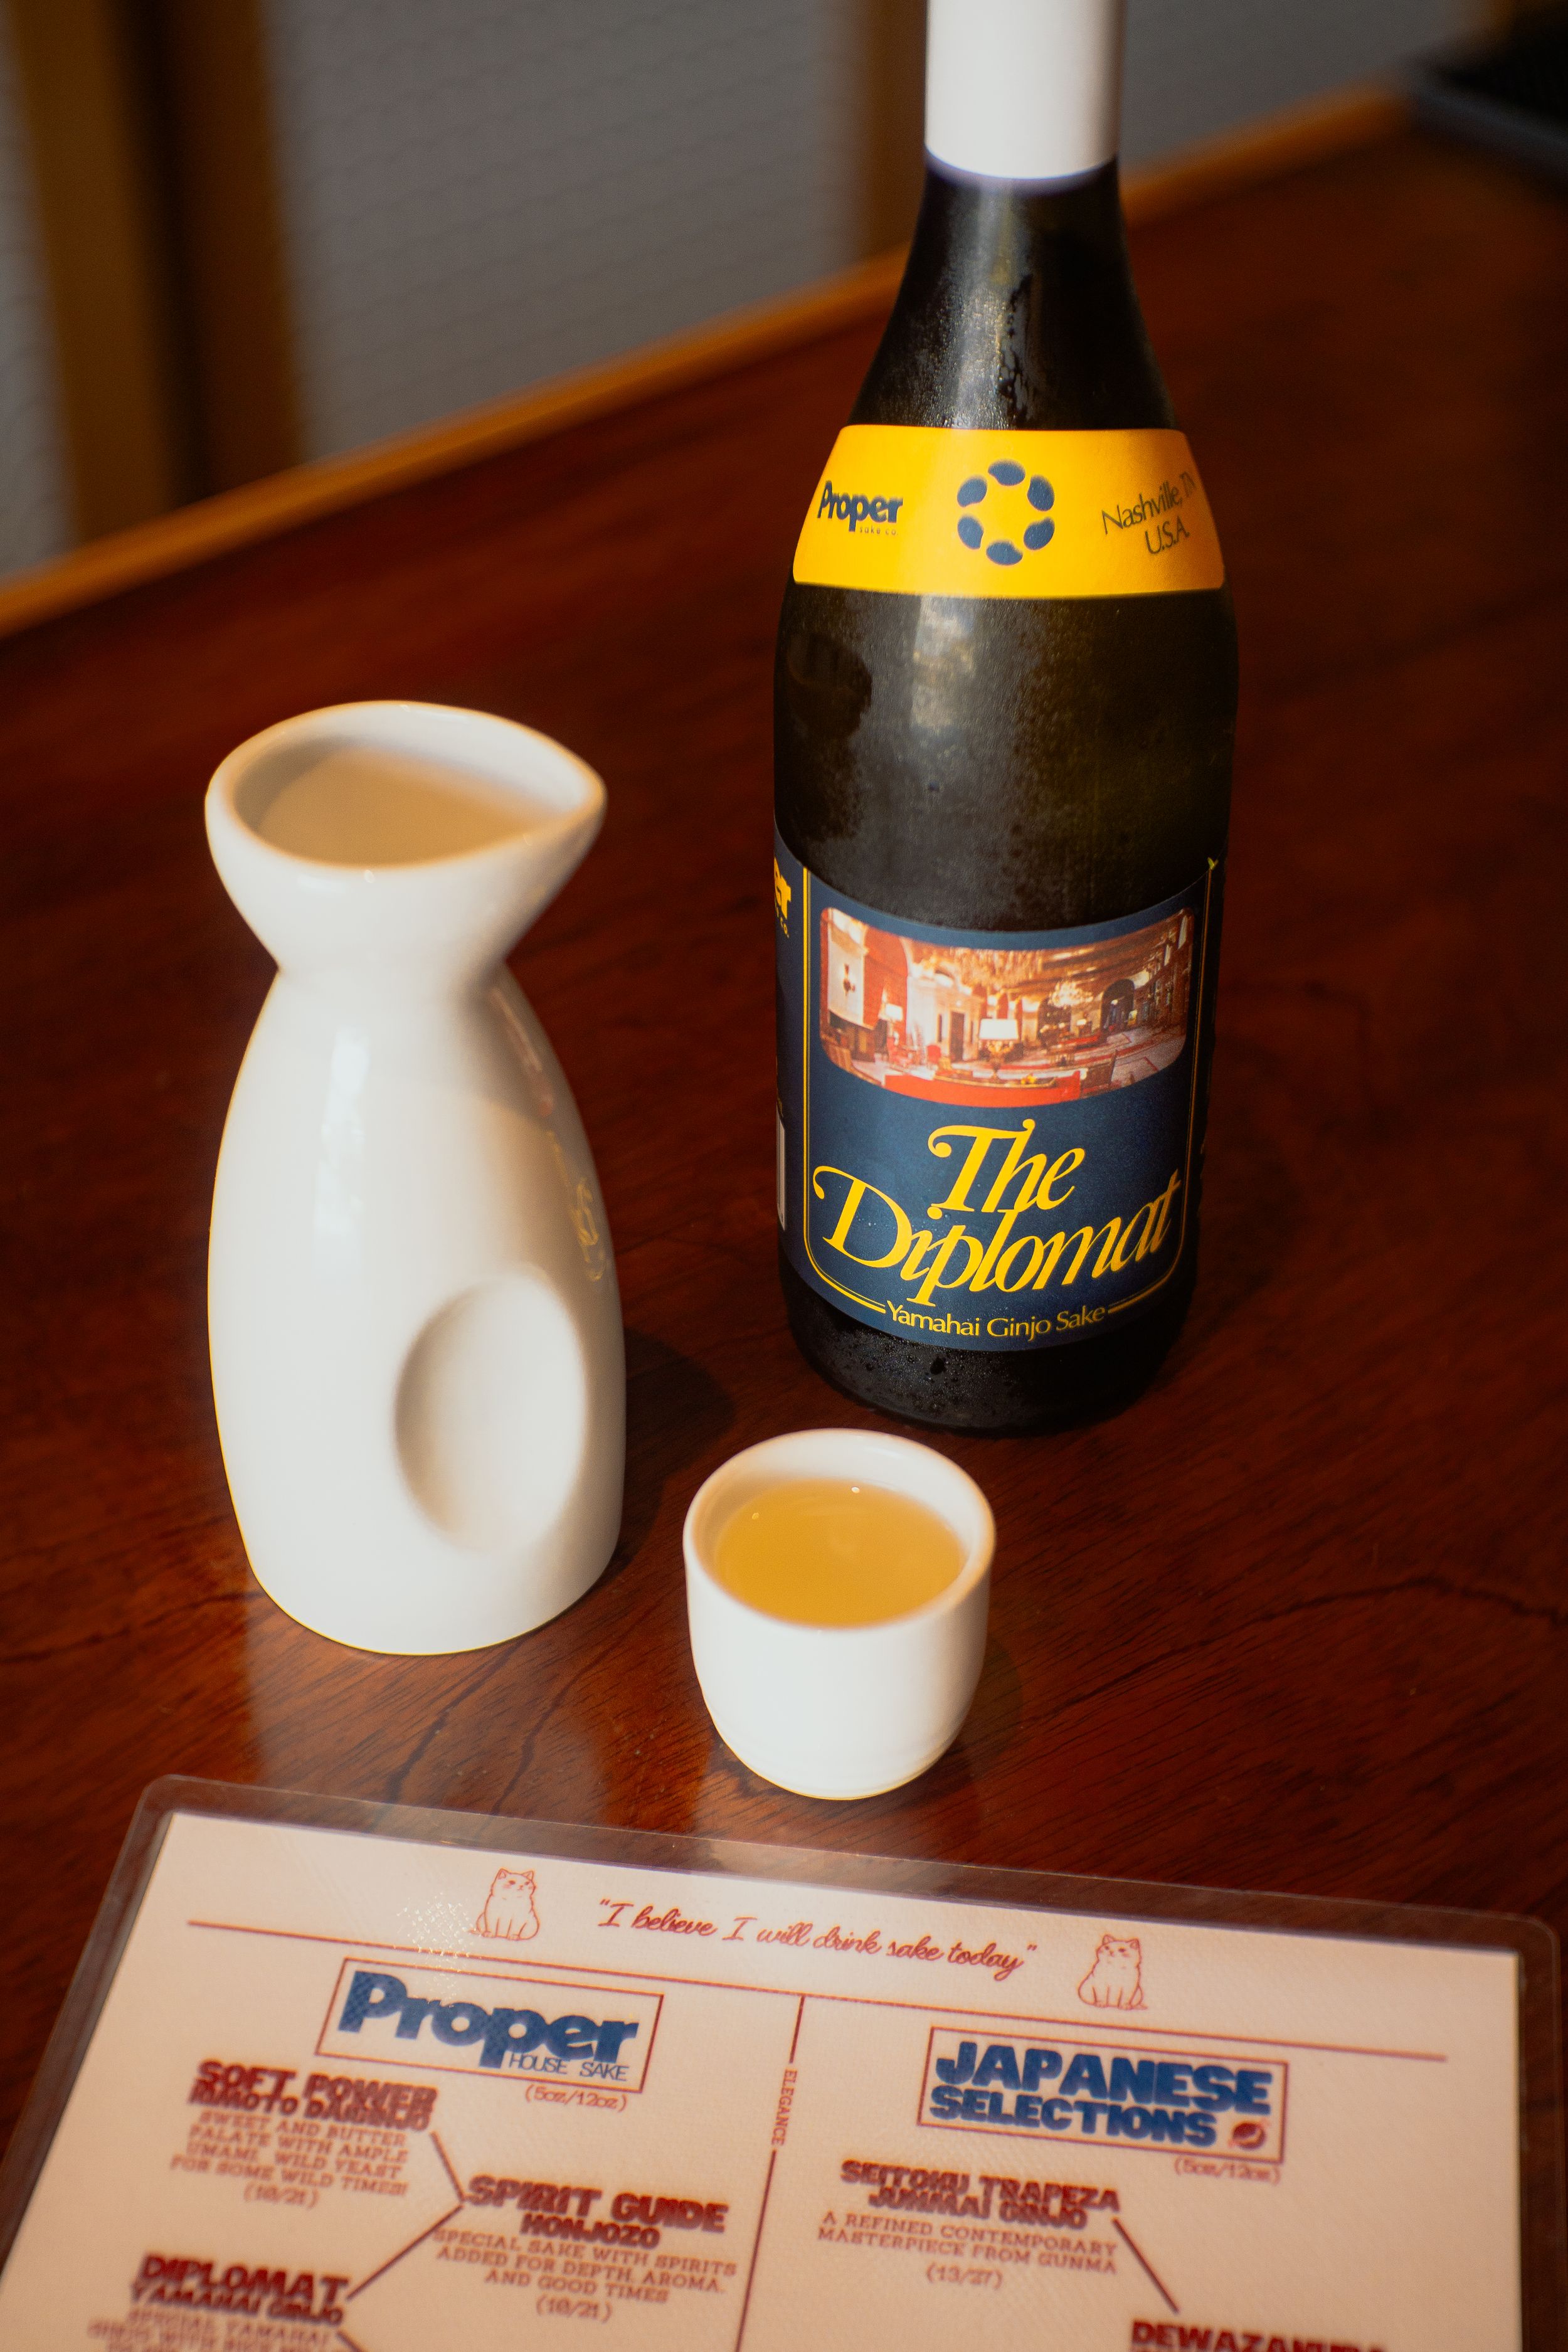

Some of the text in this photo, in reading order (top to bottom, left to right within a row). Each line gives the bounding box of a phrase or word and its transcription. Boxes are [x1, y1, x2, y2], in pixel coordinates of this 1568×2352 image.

[817, 480, 903, 532] Proper
[1101, 472, 1196, 535] Nashville, TN
[859, 526, 881, 534] sake
[1145, 516, 1190, 554] U.S.A.
[928, 1119, 1085, 1213] The
[813, 1165, 1182, 1307] Diplomat
[887, 1300, 1105, 1342] Yamahai Ginjo Sake
[598, 1899, 634, 1927] "I
[631, 1905, 718, 1936] believe
[722, 1917, 758, 1941] I
[756, 1921, 813, 1947] will
[812, 1926, 882, 1954] drink
[886, 1934, 944, 1961] sake
[337, 1970, 640, 2069] Proper
[198, 2060, 438, 2114] SOFT POWER
[508, 2053, 630, 2082] HOUSE SAKE
[936, 2042, 1273, 2115] JAPANESE
[199, 2109, 407, 2148] SWEET AND BUTTER
[771, 2069, 798, 2146] ELEGANCE
[930, 2085, 1217, 2147] SELECTIONS
[188, 2124, 409, 2164] PALATE WITH AMPLE
[274, 2151, 327, 2171] WILD
[336, 2158, 403, 2180] YEAST
[170, 2153, 211, 2173] FOR
[216, 2160, 276, 2181] SOME
[282, 2168, 334, 2189] WILD
[979, 2175, 1120, 2213] TRAPEZA
[466, 2174, 729, 2233] SPIRIT GUIDE
[433, 2228, 738, 2277] SPECIAL SAKE WITH SPIRITS
[519, 2212, 661, 2250] HONJOZO
[817, 2227, 1118, 2274] MASTERPIECE FROM GUNMA
[822, 2210, 1118, 2257] A REFINED CONTEMPORARY
[140, 2254, 350, 2306] DIPLOMAT
[437, 2245, 509, 2269] ADDED
[514, 2255, 555, 2274] FOR
[484, 2269, 670, 2304] AND GOOD TIMES
